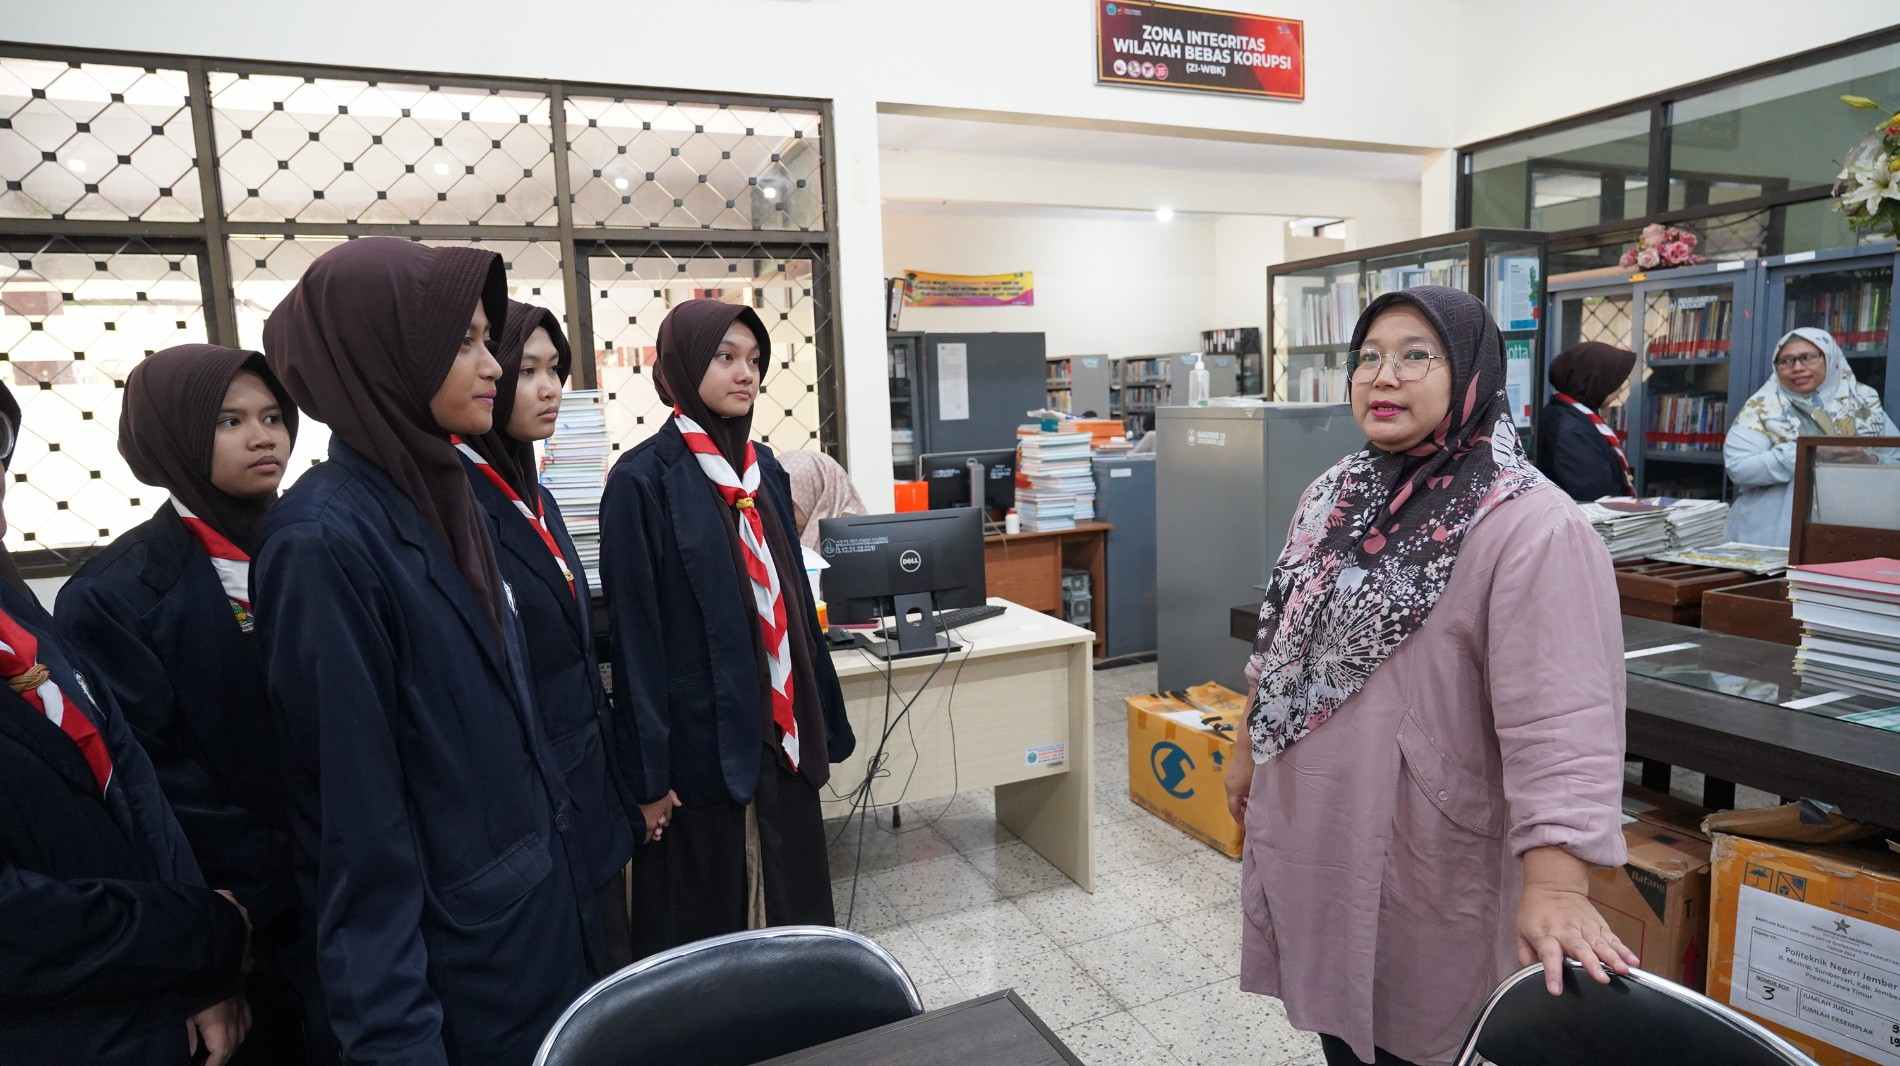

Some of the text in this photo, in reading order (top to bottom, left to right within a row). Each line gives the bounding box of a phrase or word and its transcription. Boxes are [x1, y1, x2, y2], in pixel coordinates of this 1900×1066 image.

[1142, 25, 1265, 52] ZONA INTEGRITAS
[1113, 38, 1292, 70] WILAYAH BEBAS KORUPSI
[1186, 63, 1226, 77] (ZI-WBK)
[1785, 946, 1827, 966] Politeknik
[1830, 962, 1860, 977] Negeri
[1863, 973, 1898, 990] Jember
[1762, 985, 1775, 1000] 3
[1803, 993, 1831, 1006] JUMLAH
[1802, 1005, 1830, 1019] JUMLAH
